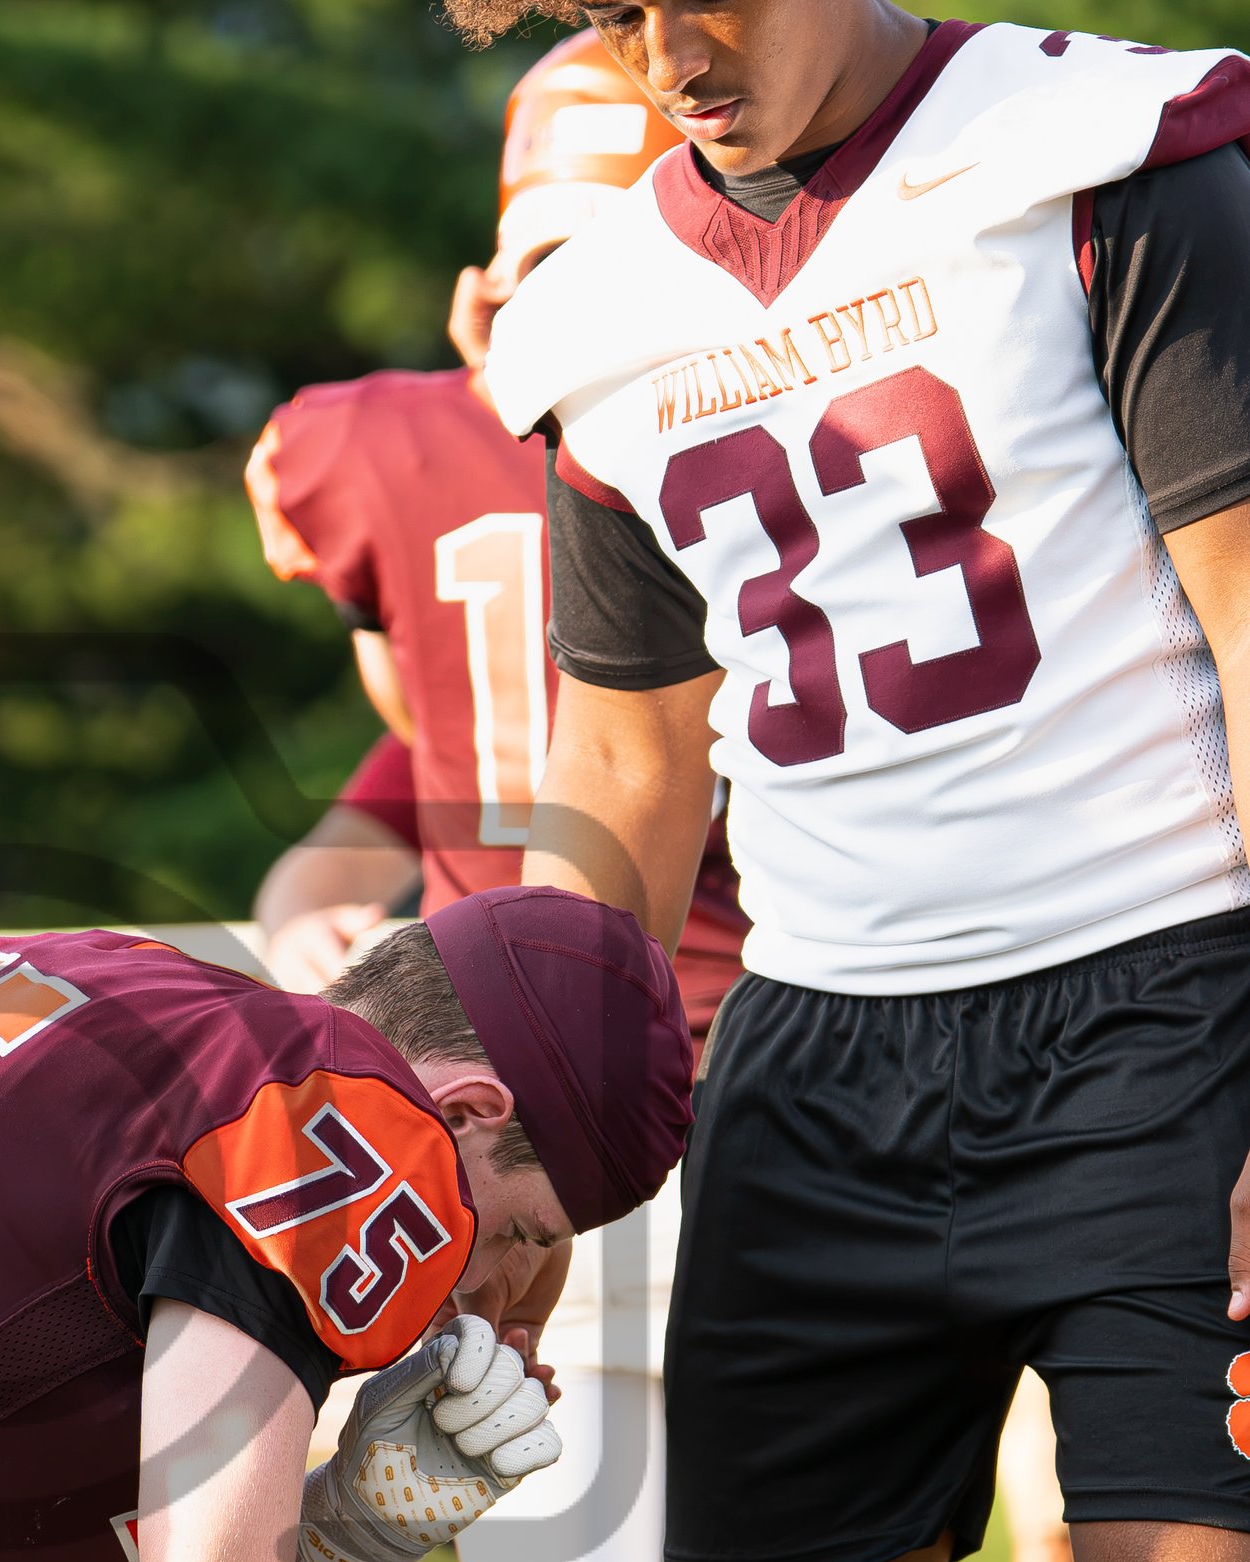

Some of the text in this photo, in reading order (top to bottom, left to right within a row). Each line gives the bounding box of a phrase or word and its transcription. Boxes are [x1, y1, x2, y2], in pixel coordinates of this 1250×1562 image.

[652, 276, 938, 433] WILLIAM BYRD
[659, 364, 1041, 767] 33
[224, 1101, 452, 1335] 75
